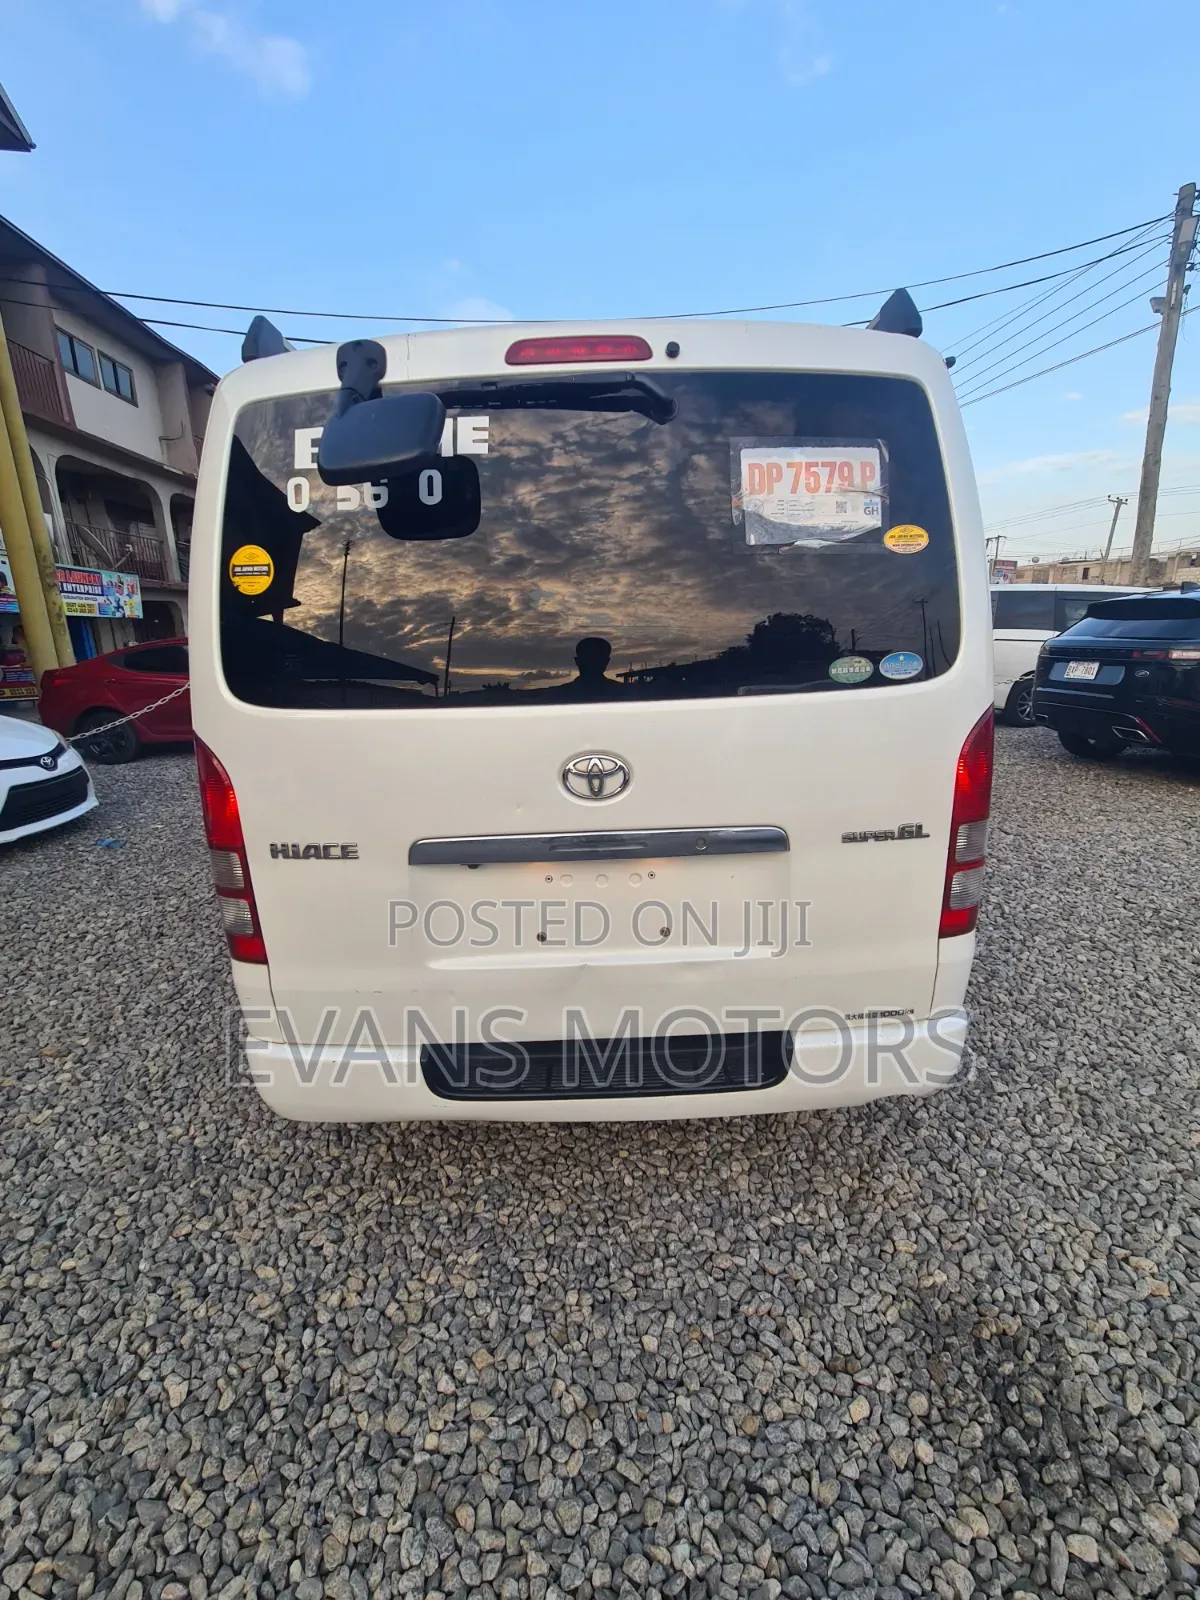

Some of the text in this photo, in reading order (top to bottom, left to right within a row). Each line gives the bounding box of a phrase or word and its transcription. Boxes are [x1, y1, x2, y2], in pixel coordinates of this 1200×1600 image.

[748, 461, 876, 495] DP 7579 P
[863, 506, 879, 516] GH
[66, 570, 101, 585] LAUNDRY
[63, 582, 102, 594] ENTERPRISE
[269, 842, 360, 860] HIACE
